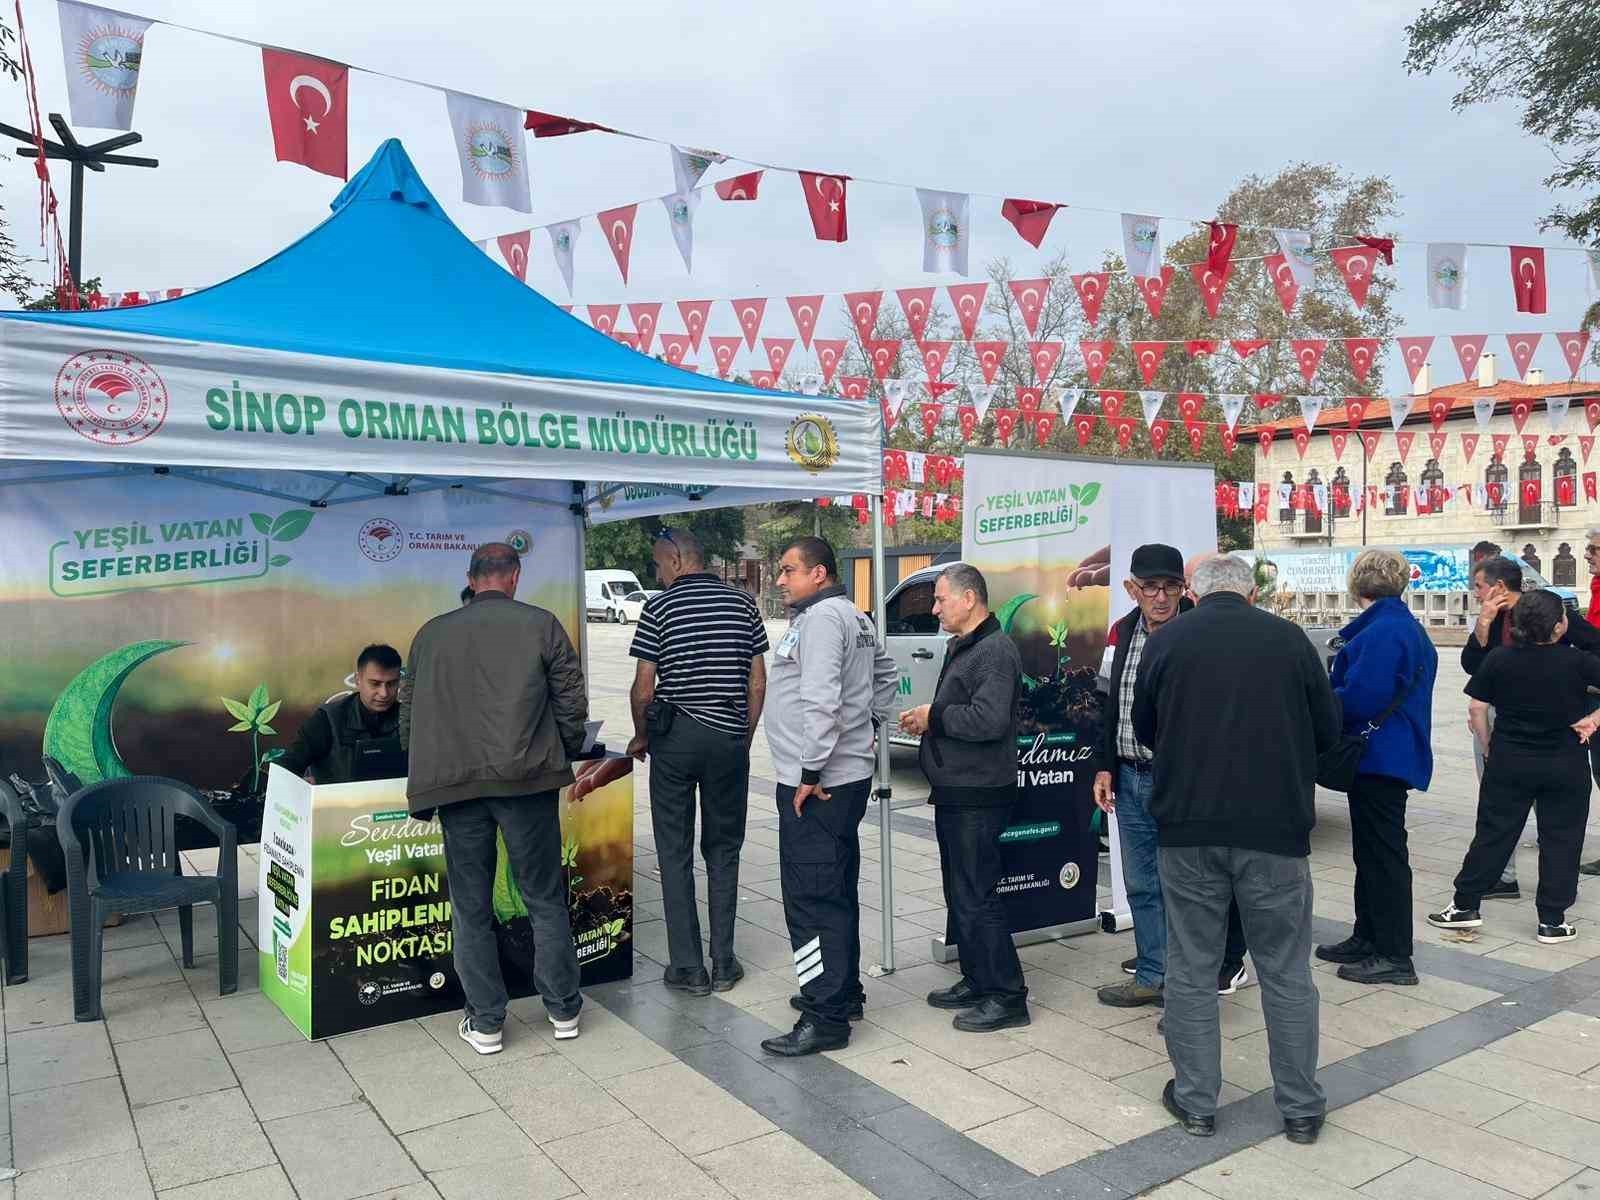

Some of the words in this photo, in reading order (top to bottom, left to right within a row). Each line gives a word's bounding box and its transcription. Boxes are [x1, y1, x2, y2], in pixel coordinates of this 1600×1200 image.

[206, 380, 326, 435] SİNOP
[338, 398, 466, 443] ORMAN
[475, 401, 581, 449] BÖLGE
[587, 411, 758, 460] MÜDÜRLÜĞÜ
[986, 490, 1024, 512] YEŞİL
[1027, 488, 1066, 506] VATAN
[979, 504, 1073, 533] SEFERBERLİĞİ
[73, 521, 154, 552] YEŞİL
[160, 518, 243, 542] VATAN
[408, 542, 441, 551] ORMAN
[444, 543, 480, 552] BAKANLI
[426, 533, 453, 541] TARIM
[62, 540, 258, 582] SEFERBERLİĞİ
[1017, 732, 1094, 765] damız
[1029, 770, 1074, 786] Vatan
[341, 815, 443, 847] Sevdam
[365, 844, 401, 866] Yeşil
[1027, 873, 1035, 881] VE
[356, 931, 452, 967] NOKTASI
[577, 936, 607, 958] BERLİĞİ
